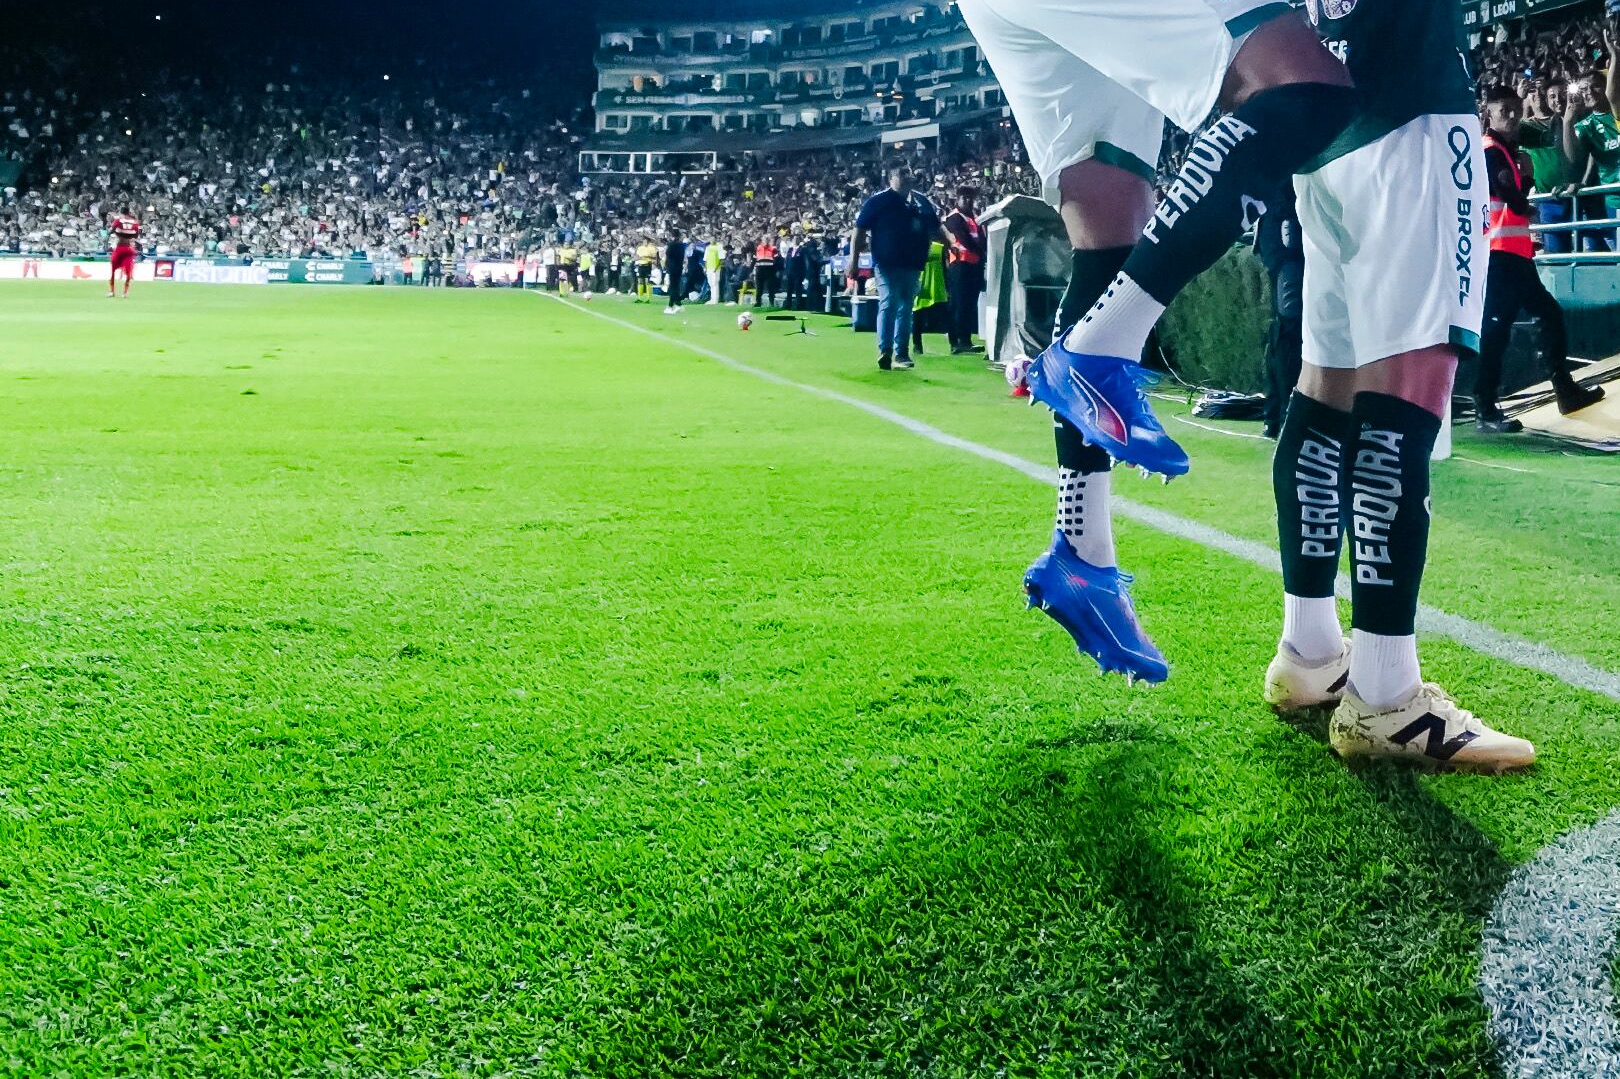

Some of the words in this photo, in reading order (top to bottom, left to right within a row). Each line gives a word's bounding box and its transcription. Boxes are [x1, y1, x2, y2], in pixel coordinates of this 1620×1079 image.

[1493, 0, 1516, 18] LEÓN
[1143, 111, 1259, 244] PERDURA
[1456, 196, 1472, 307] BROXEL
[1352, 428, 1404, 587] PERDURA
